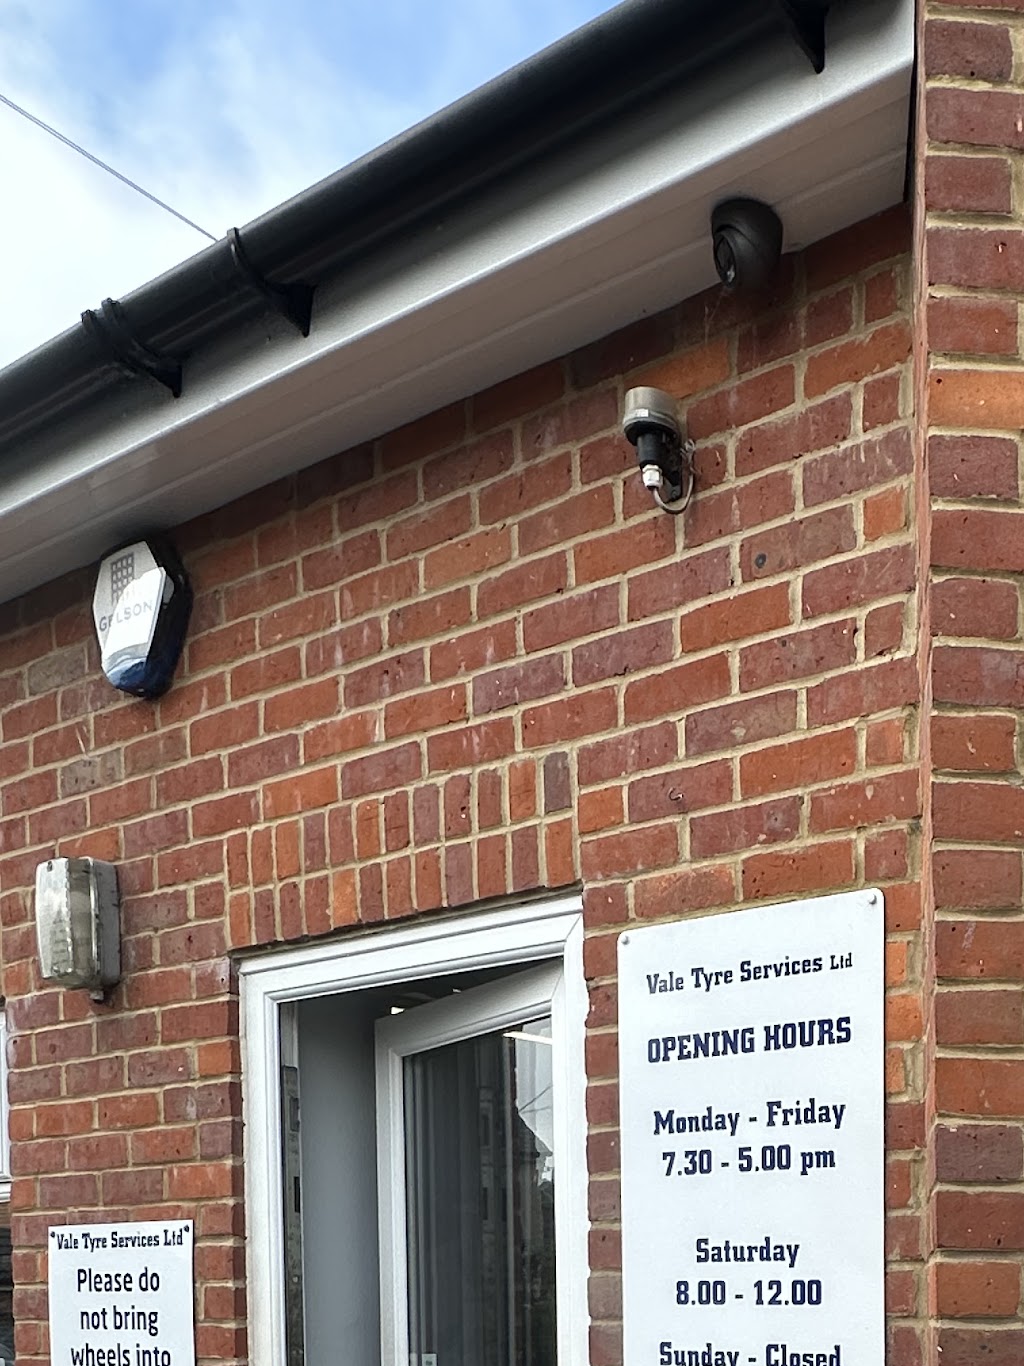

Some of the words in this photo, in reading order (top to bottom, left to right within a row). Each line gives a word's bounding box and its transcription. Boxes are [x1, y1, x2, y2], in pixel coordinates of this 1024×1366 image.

[646, 971, 684, 994] Vale
[691, 966, 733, 992] Tyre
[740, 954, 823, 982] Services
[830, 952, 853, 969] Ltd
[647, 1027, 755, 1063] OPENING
[763, 1016, 851, 1052] HOURS
[653, 1106, 740, 1136] Monday
[766, 1098, 846, 1129] Friday
[662, 1149, 712, 1176] 7.30
[738, 1144, 791, 1172] 5.00
[800, 1147, 836, 1176] pm
[57, 1233, 79, 1250] Vale
[82, 1232, 108, 1252] Tyre
[110, 1231, 160, 1248] Services
[163, 1228, 184, 1246] Ltd
[696, 1237, 800, 1268] Saturday
[77, 1268, 133, 1292] Please
[138, 1266, 160, 1292] do
[676, 1280, 726, 1305] 8.00
[753, 1279, 822, 1305] 12.00
[80, 1307, 108, 1330] not
[112, 1305, 158, 1336] bring
